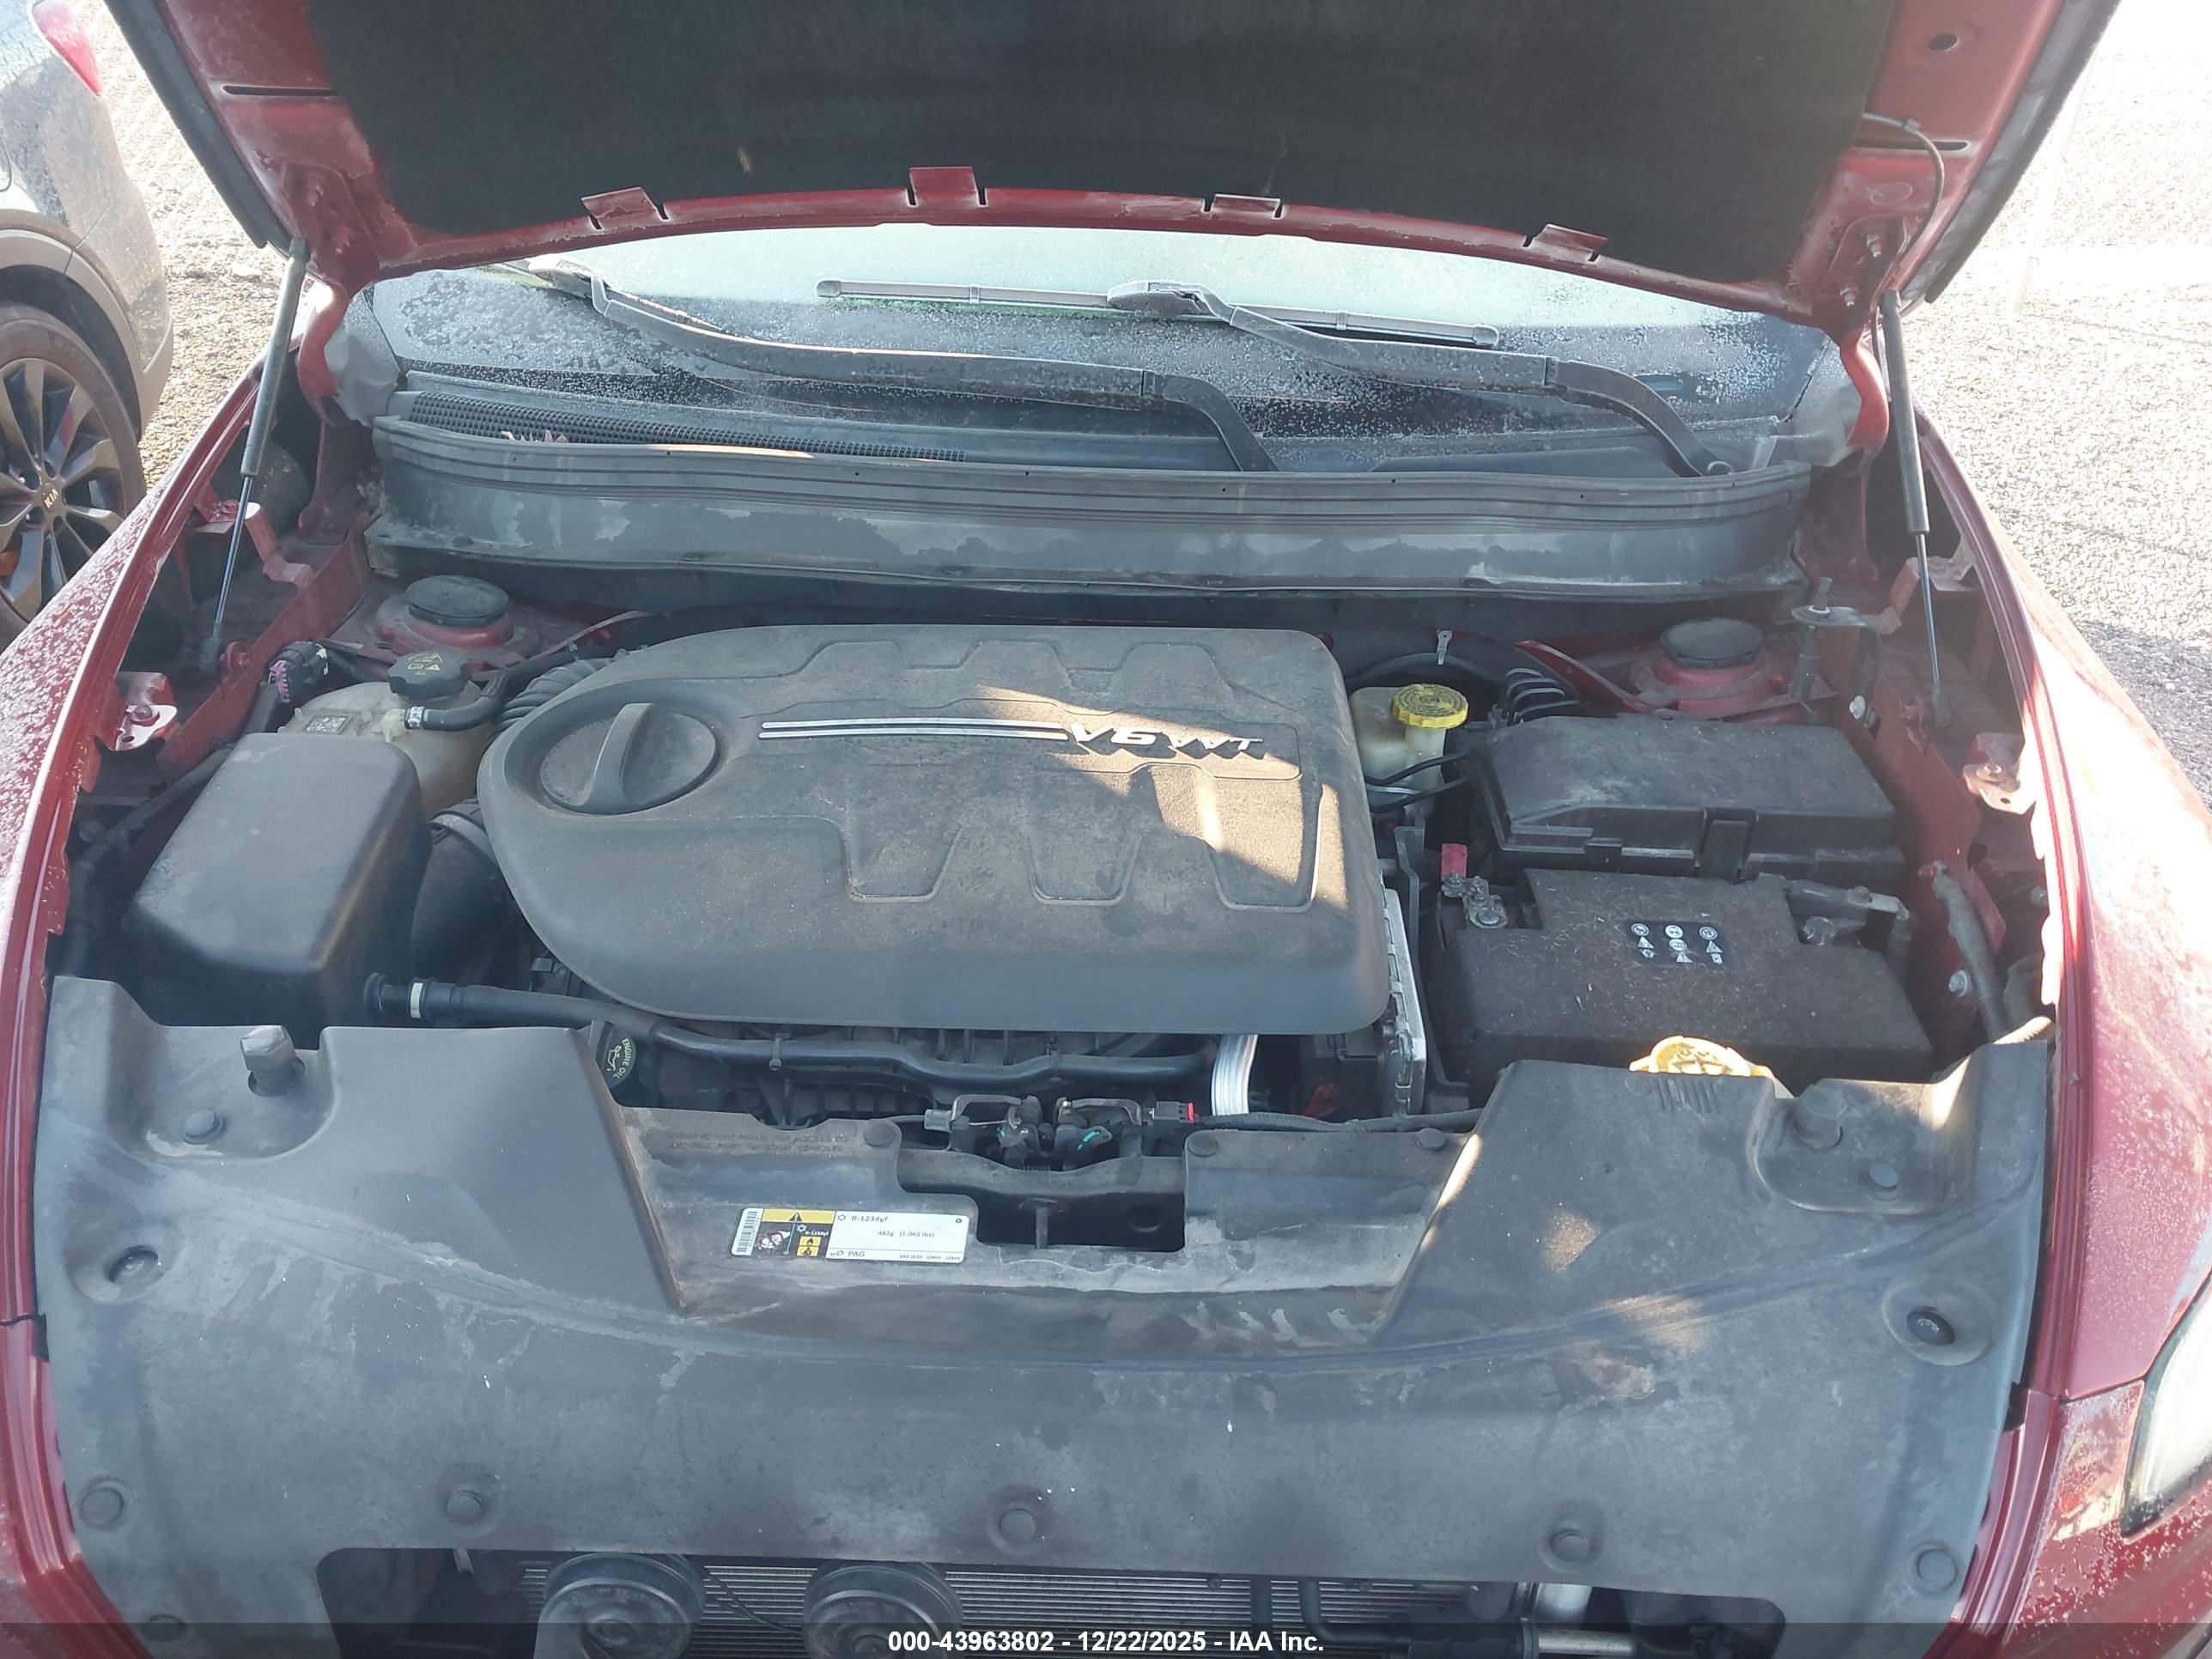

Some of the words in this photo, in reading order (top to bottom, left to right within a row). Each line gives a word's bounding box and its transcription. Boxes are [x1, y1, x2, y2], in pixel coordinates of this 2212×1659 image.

[45, 489, 58, 507] KIA
[621, 1037, 633, 1066] ENGINE
[612, 1067, 626, 1079] OIL
